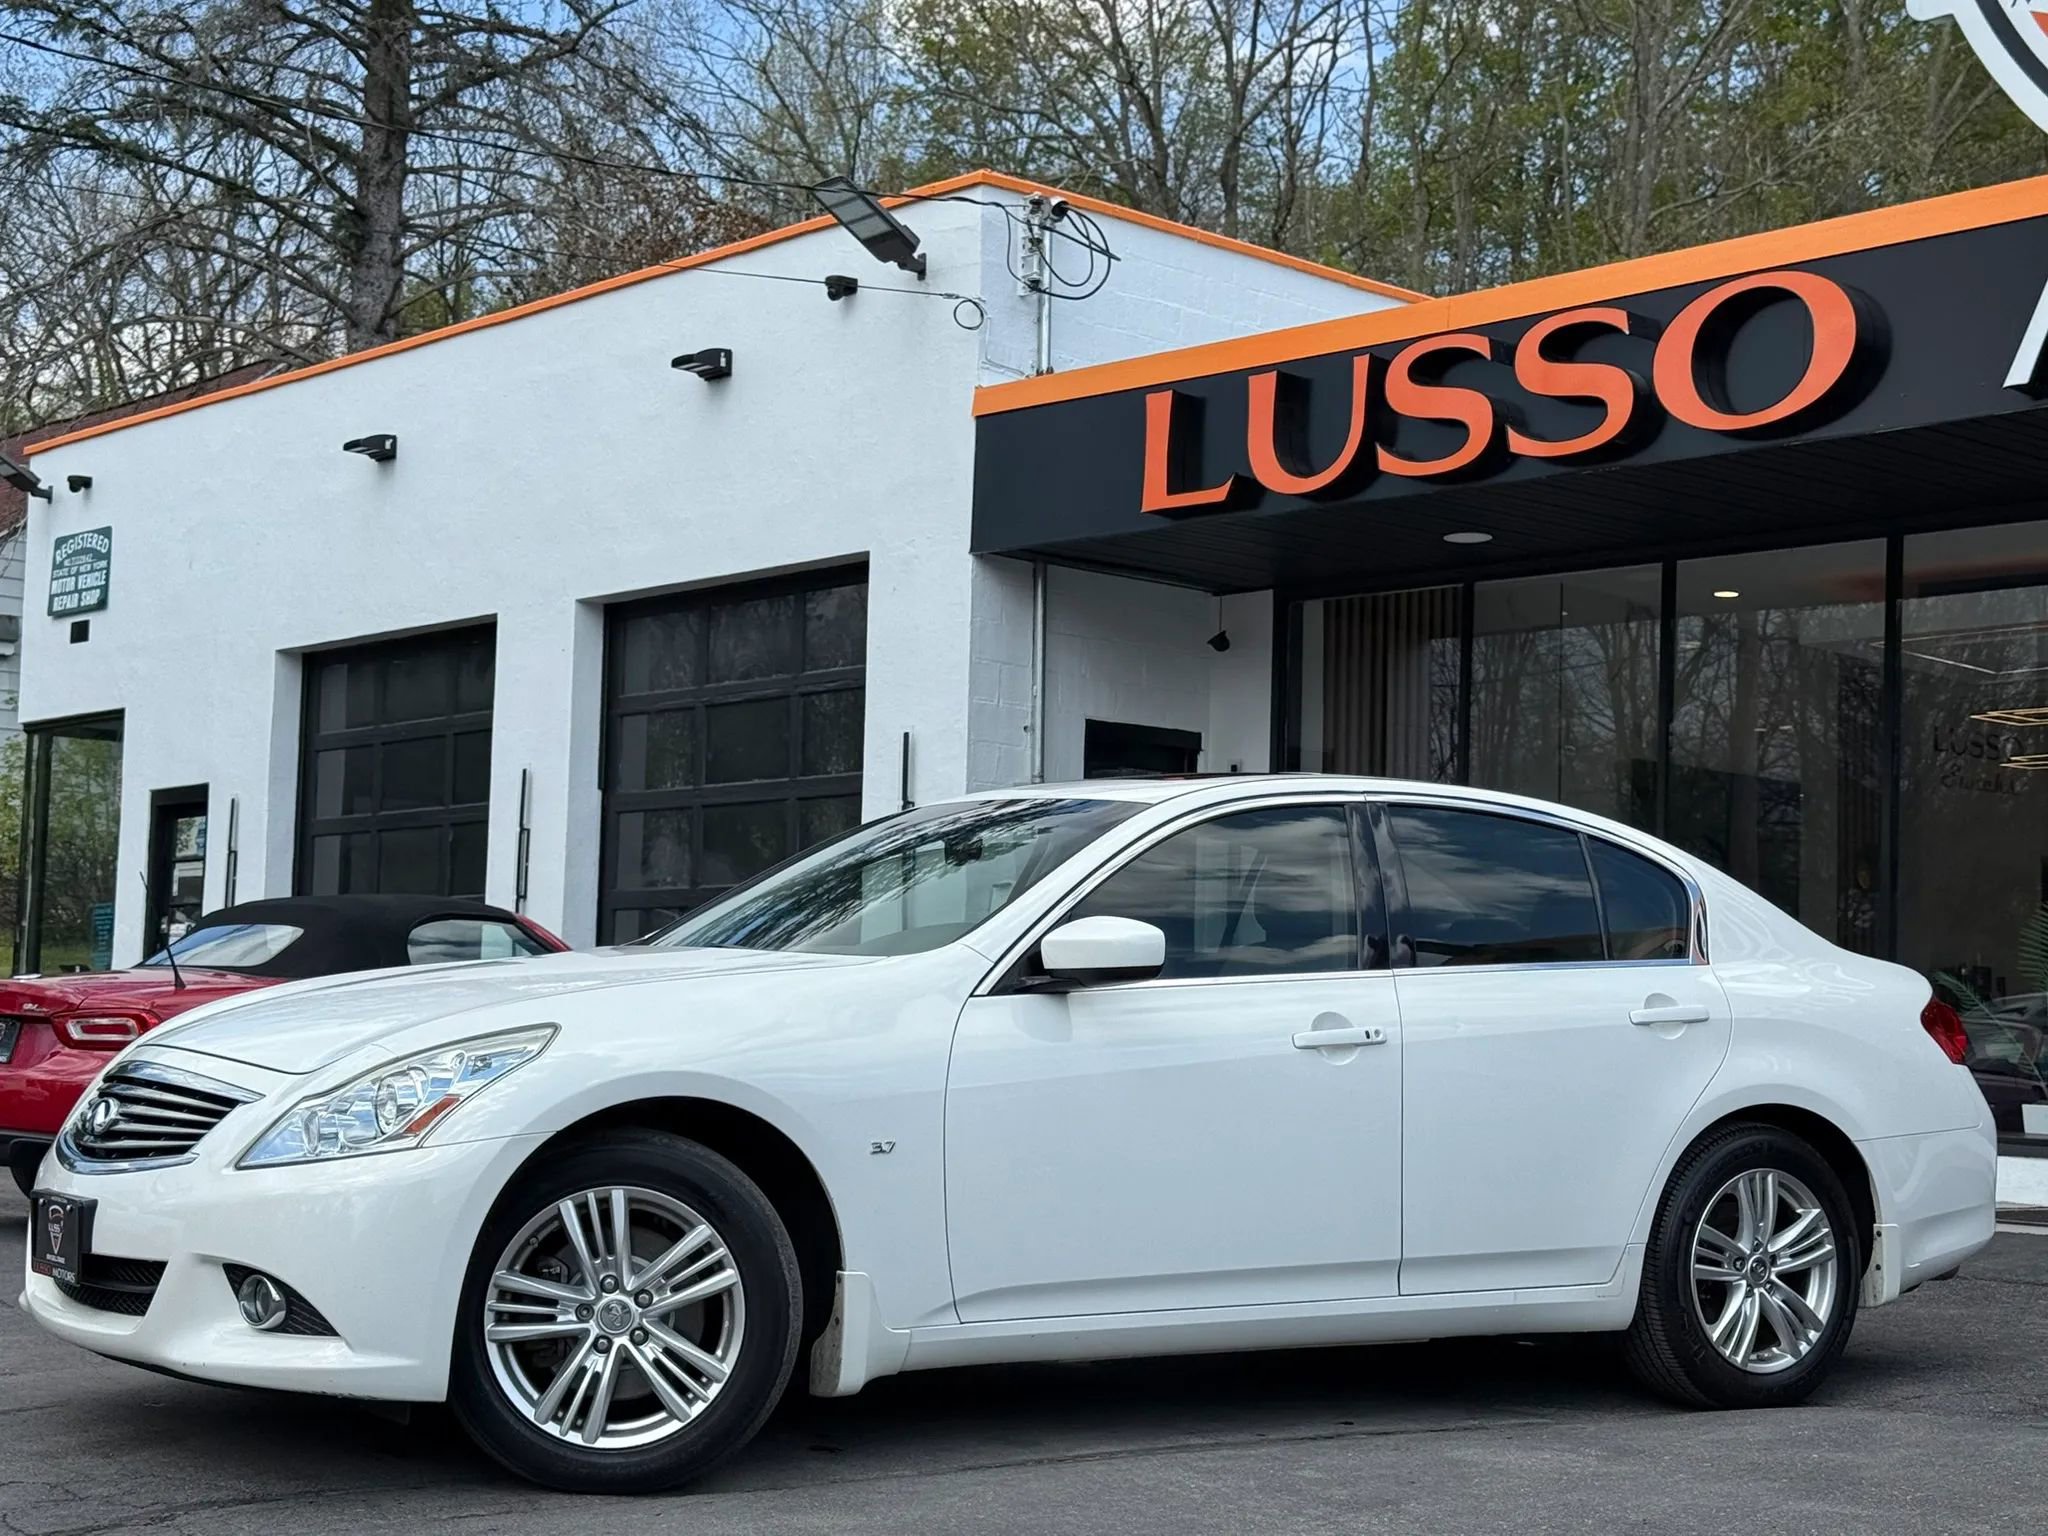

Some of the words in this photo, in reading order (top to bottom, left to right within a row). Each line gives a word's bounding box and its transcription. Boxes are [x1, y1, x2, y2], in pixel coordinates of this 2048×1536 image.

[1140, 270, 1857, 514] LUSSO
[55, 533, 109, 564] REGISTERED
[53, 567, 69, 578] STATE
[70, 566, 78, 575] OF
[80, 563, 91, 573] NEW
[93, 560, 108, 571] YORK
[51, 577, 75, 594] MOTOR
[78, 570, 106, 589] VEHICLE
[53, 593, 79, 611] REPAIR
[81, 589, 100, 606] SHOP
[52, 1268, 75, 1283] MOTORS
